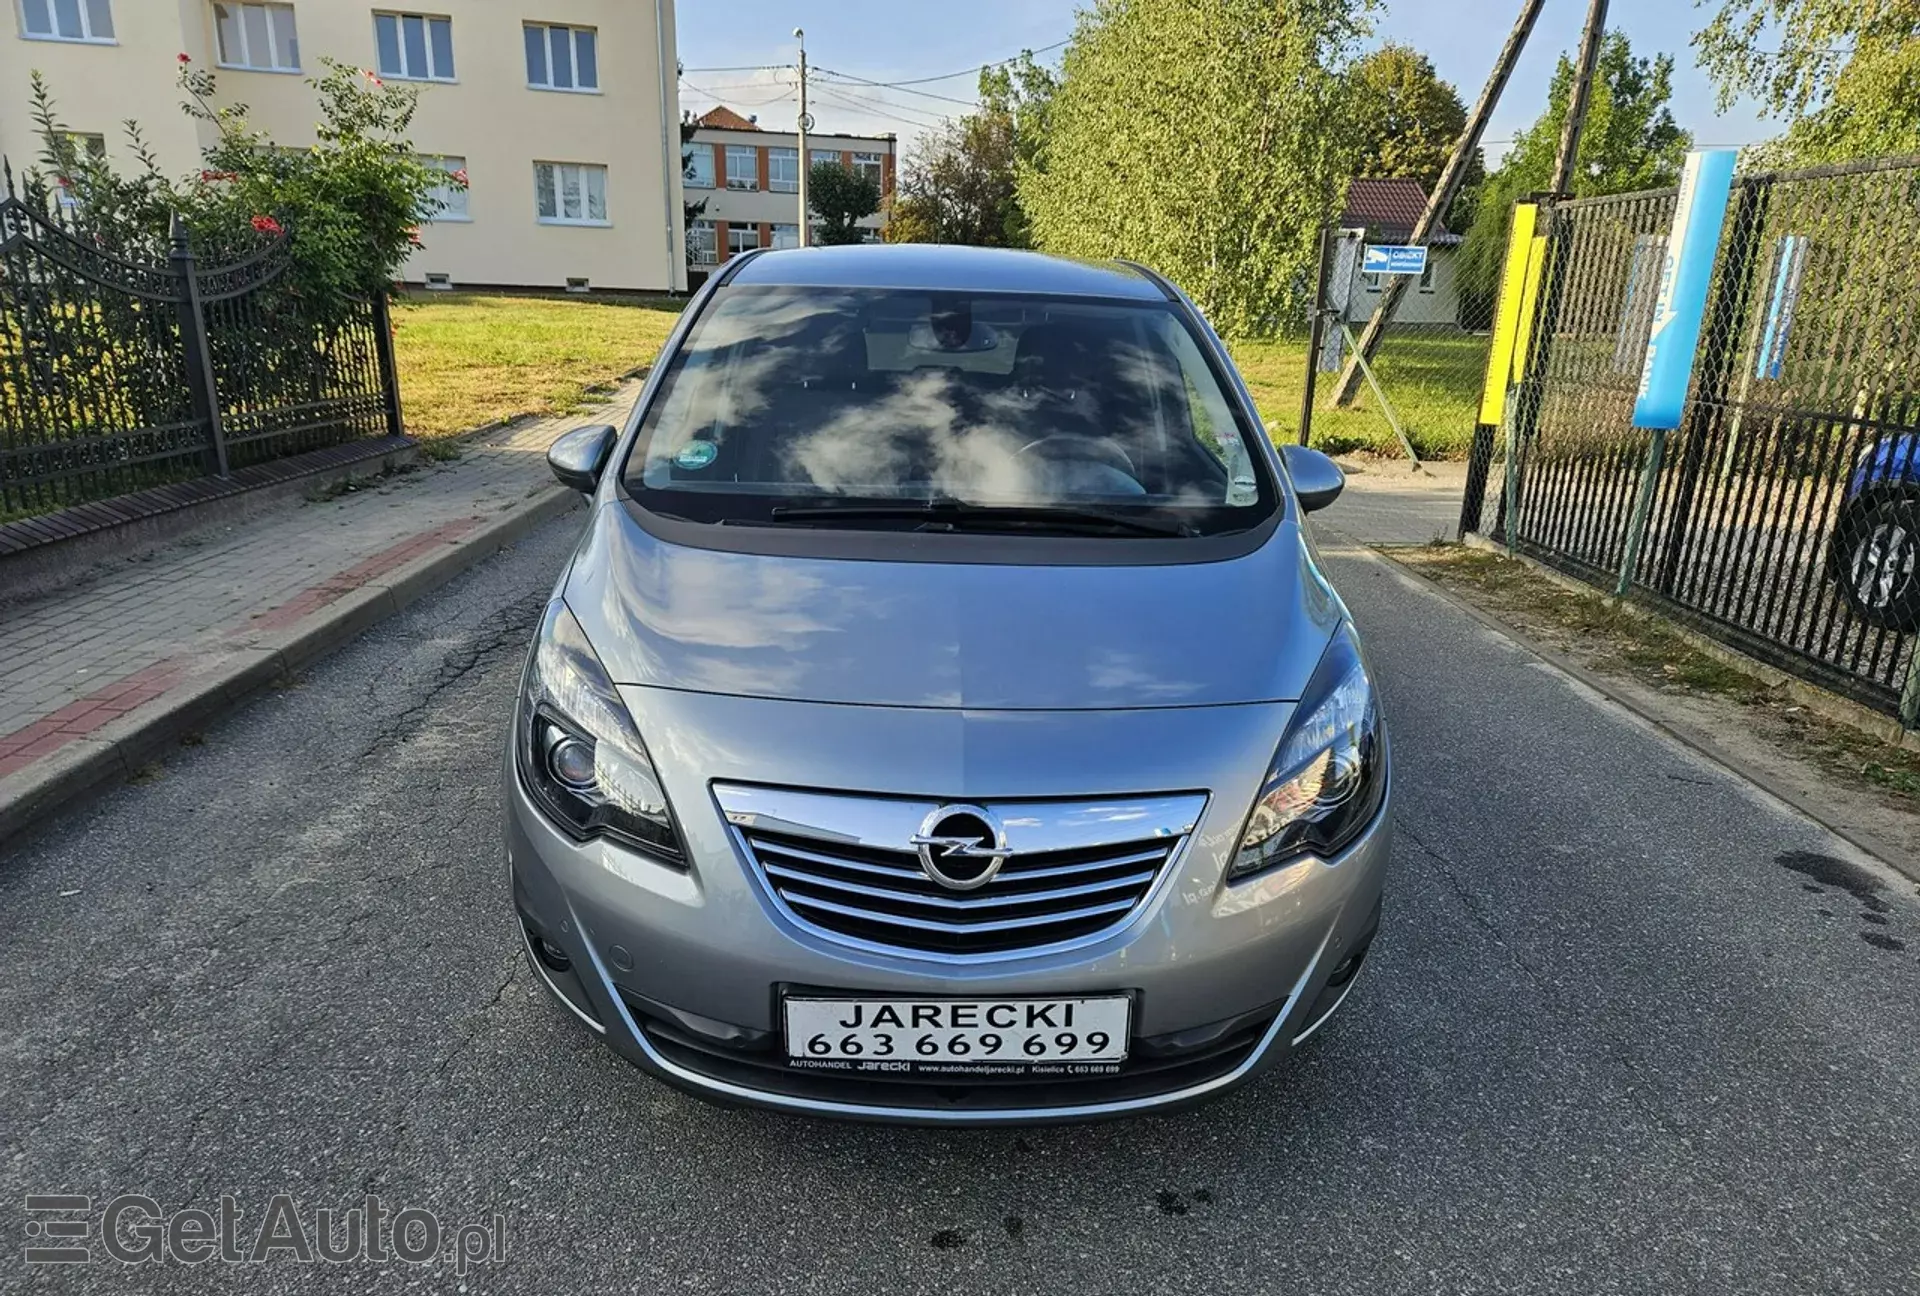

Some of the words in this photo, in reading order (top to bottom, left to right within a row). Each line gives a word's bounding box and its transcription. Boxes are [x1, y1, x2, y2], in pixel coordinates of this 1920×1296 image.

[1637, 345, 1657, 401] BANK
[839, 1003, 1074, 1029] JARECKI
[807, 1033, 895, 1055] 663
[915, 1033, 1003, 1055] 669
[1022, 1032, 1110, 1055] 699
[789, 1060, 852, 1069] AUTOHANDEL
[918, 1065, 1025, 1075] www.autohandeljarecki.pl
